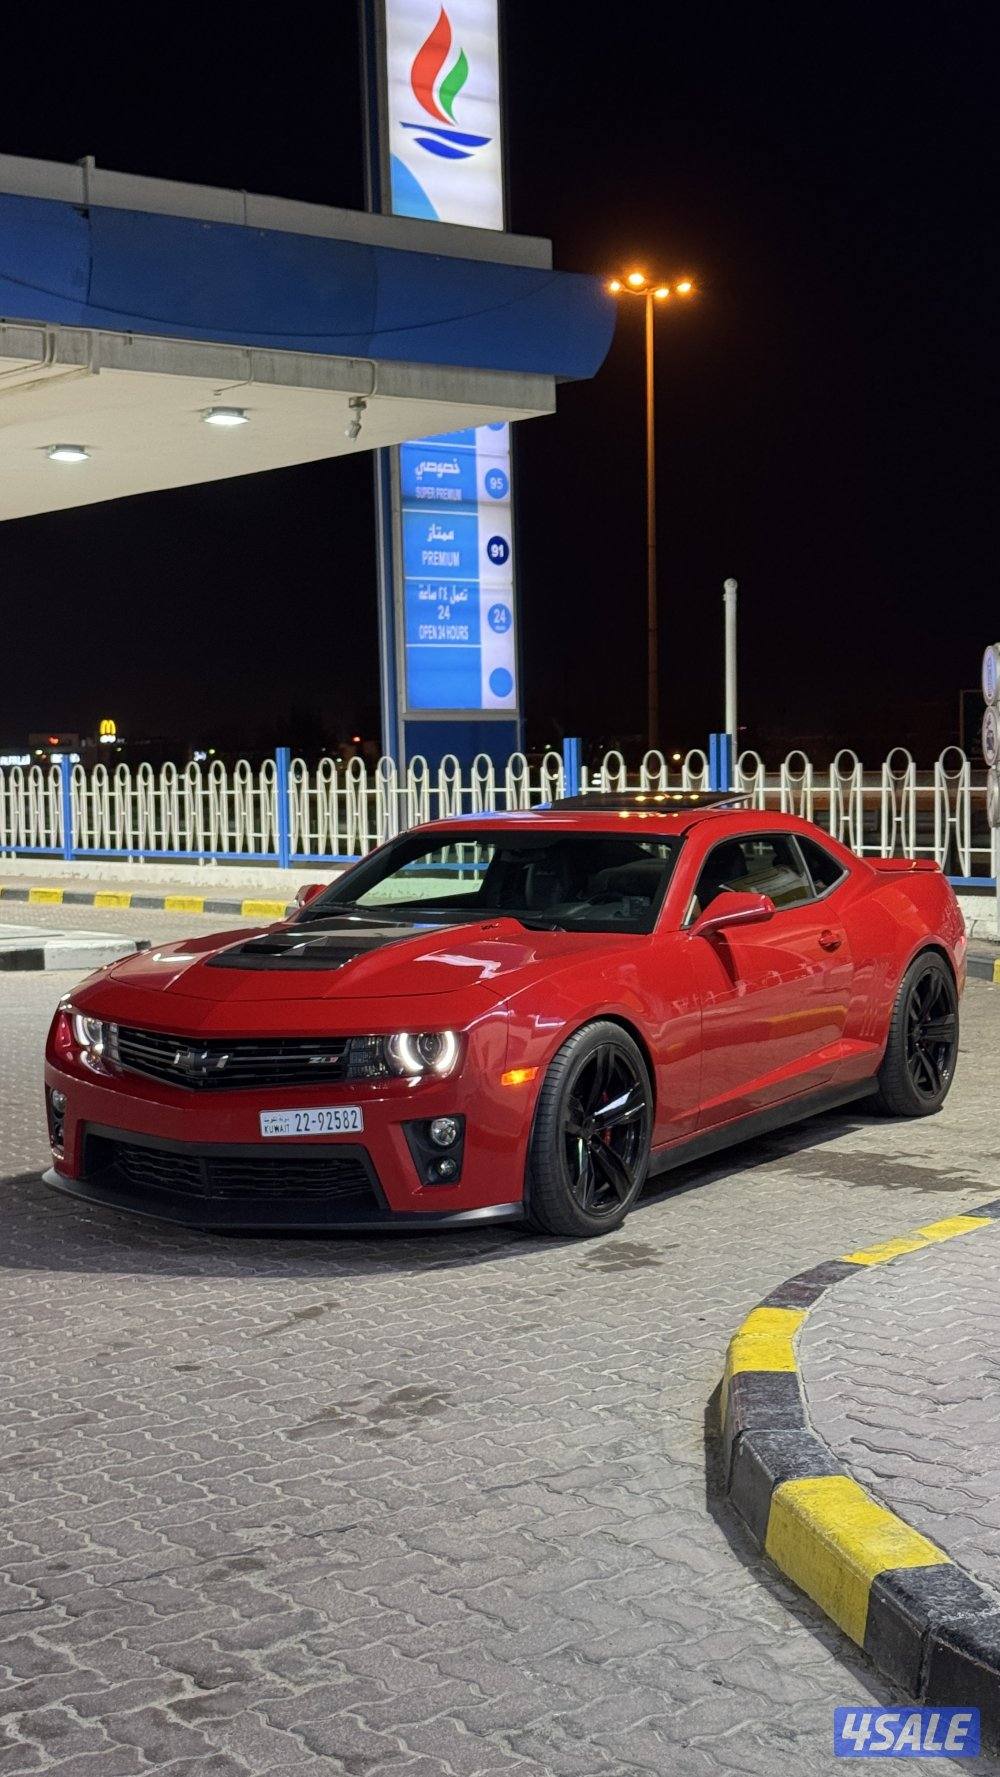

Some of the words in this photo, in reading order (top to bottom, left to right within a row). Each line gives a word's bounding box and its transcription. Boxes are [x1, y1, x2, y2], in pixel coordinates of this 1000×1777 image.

[414, 457, 461, 480] خصوصي
[489, 477, 504, 490] 95
[415, 486, 435, 499] SUPER
[426, 523, 455, 542] ممتاز
[422, 550, 460, 567] PREMIUM
[490, 544, 504, 558] 91
[437, 604, 450, 620] 24
[493, 608, 506, 624] 24
[419, 624, 437, 640] OPEN
[446, 624, 469, 640] HOURS
[295, 1110, 358, 1132] 22-92582
